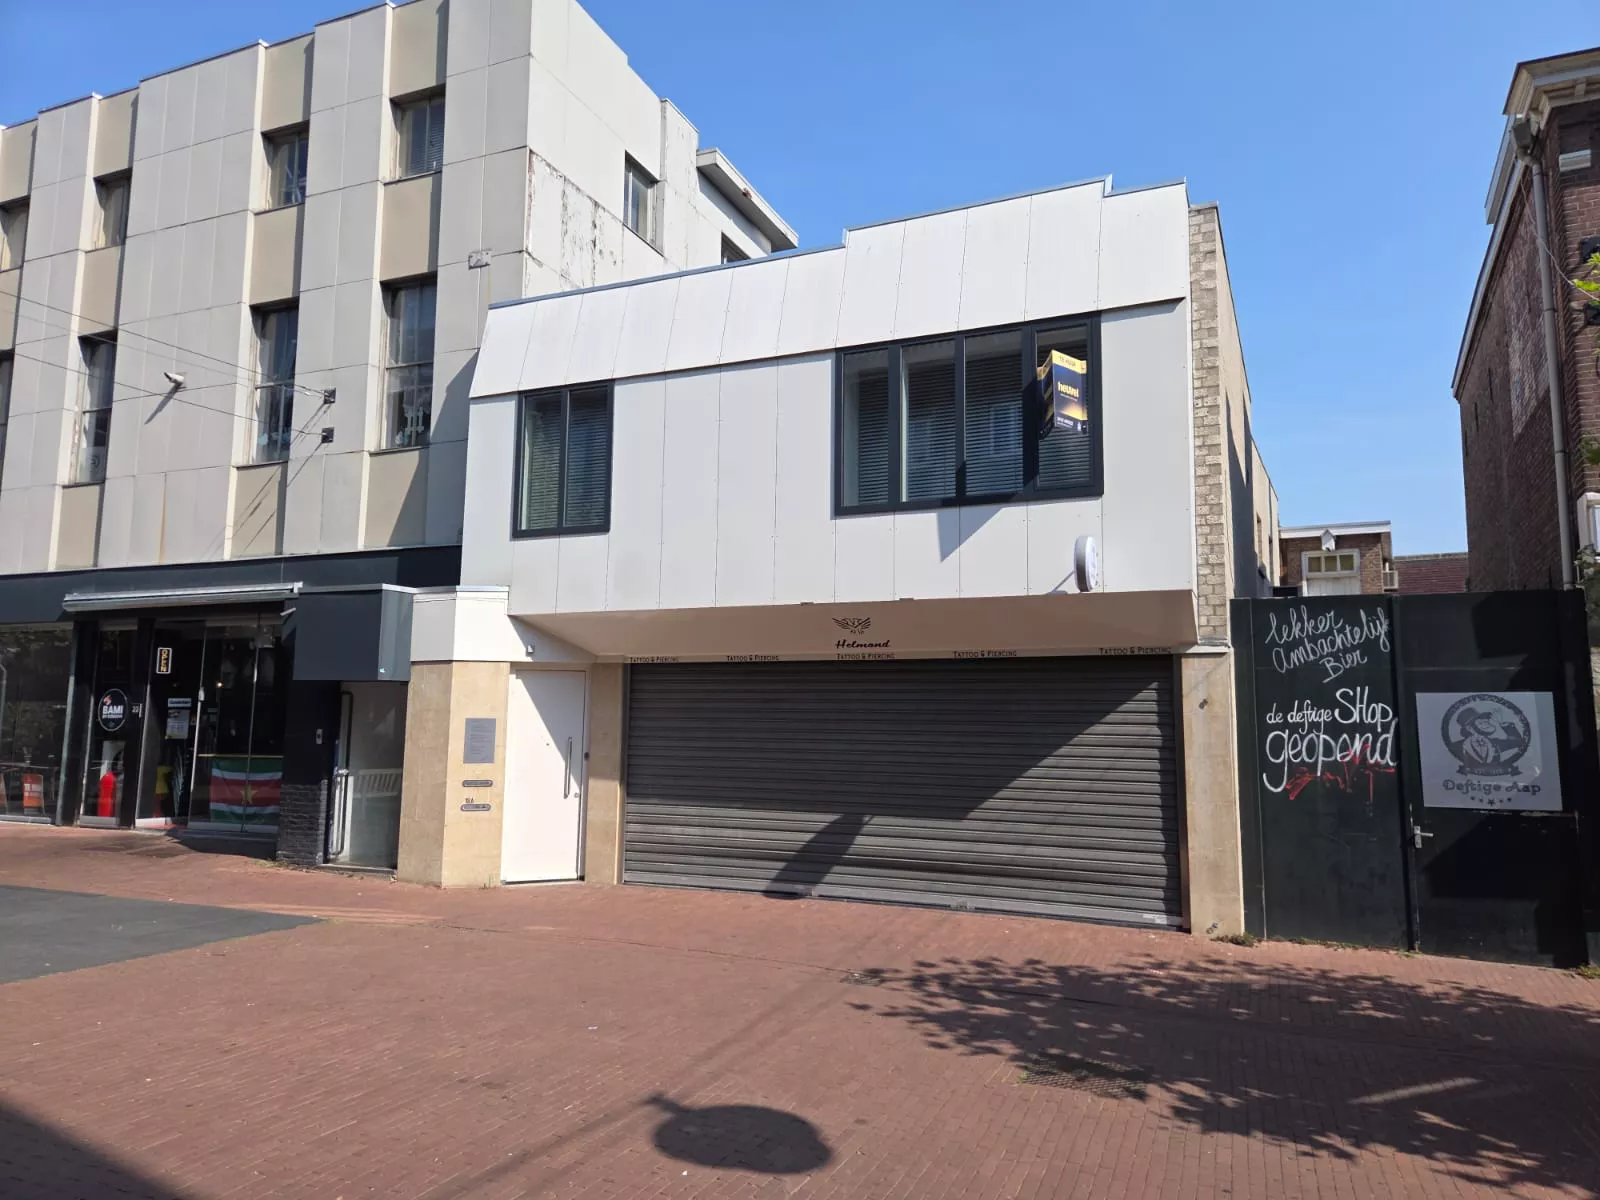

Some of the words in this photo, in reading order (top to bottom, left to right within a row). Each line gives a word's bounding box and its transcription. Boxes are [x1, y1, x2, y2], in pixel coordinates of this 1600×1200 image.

[1319, 650, 1368, 684] Bier
[102, 705, 124, 714] BAMI
[1266, 702, 1284, 724] de
[1287, 699, 1333, 735] deftige
[1442, 779, 1502, 796] Deftige
[1505, 781, 1542, 796] Aap
